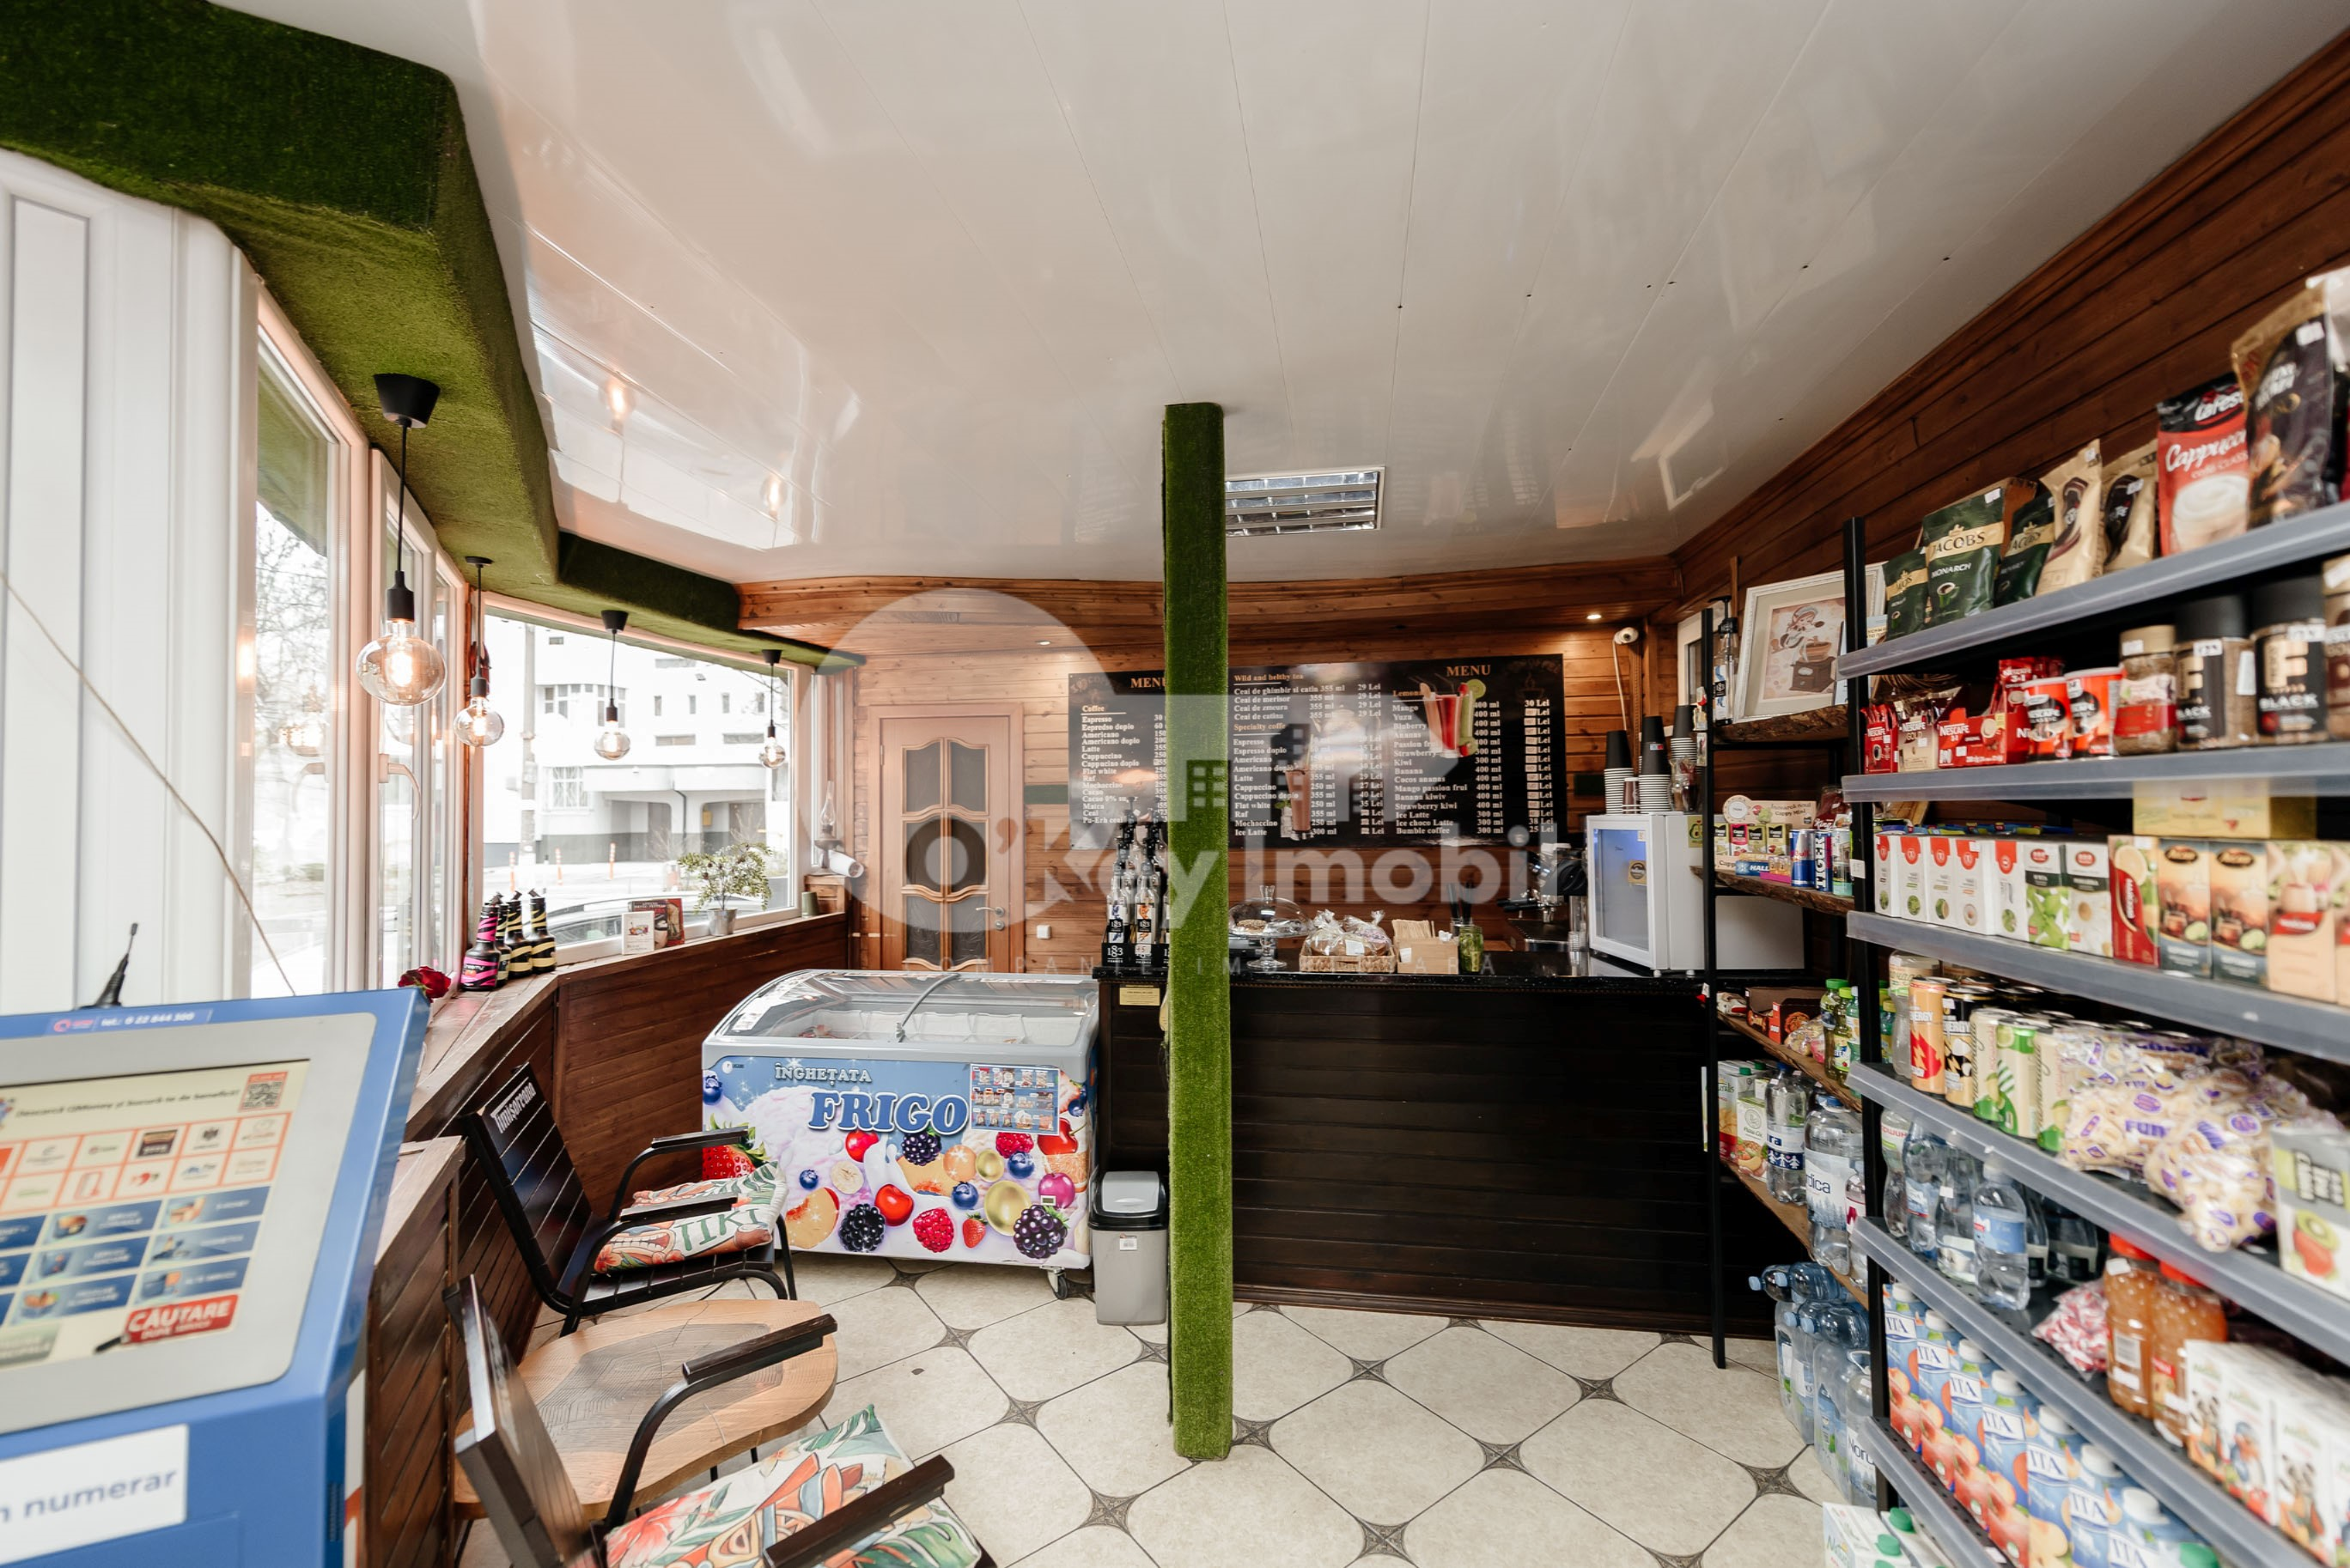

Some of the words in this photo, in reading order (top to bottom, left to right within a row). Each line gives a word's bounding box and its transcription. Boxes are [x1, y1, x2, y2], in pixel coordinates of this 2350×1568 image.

[1932, 532, 1985, 553] JACOBS
[1446, 665, 1491, 677] MENU
[1816, 836, 1826, 890] TIGER
[808, 1091, 969, 1134] FRIGO
[673, 1207, 759, 1251] TIKI
[23, 1469, 177, 1520] numerar
